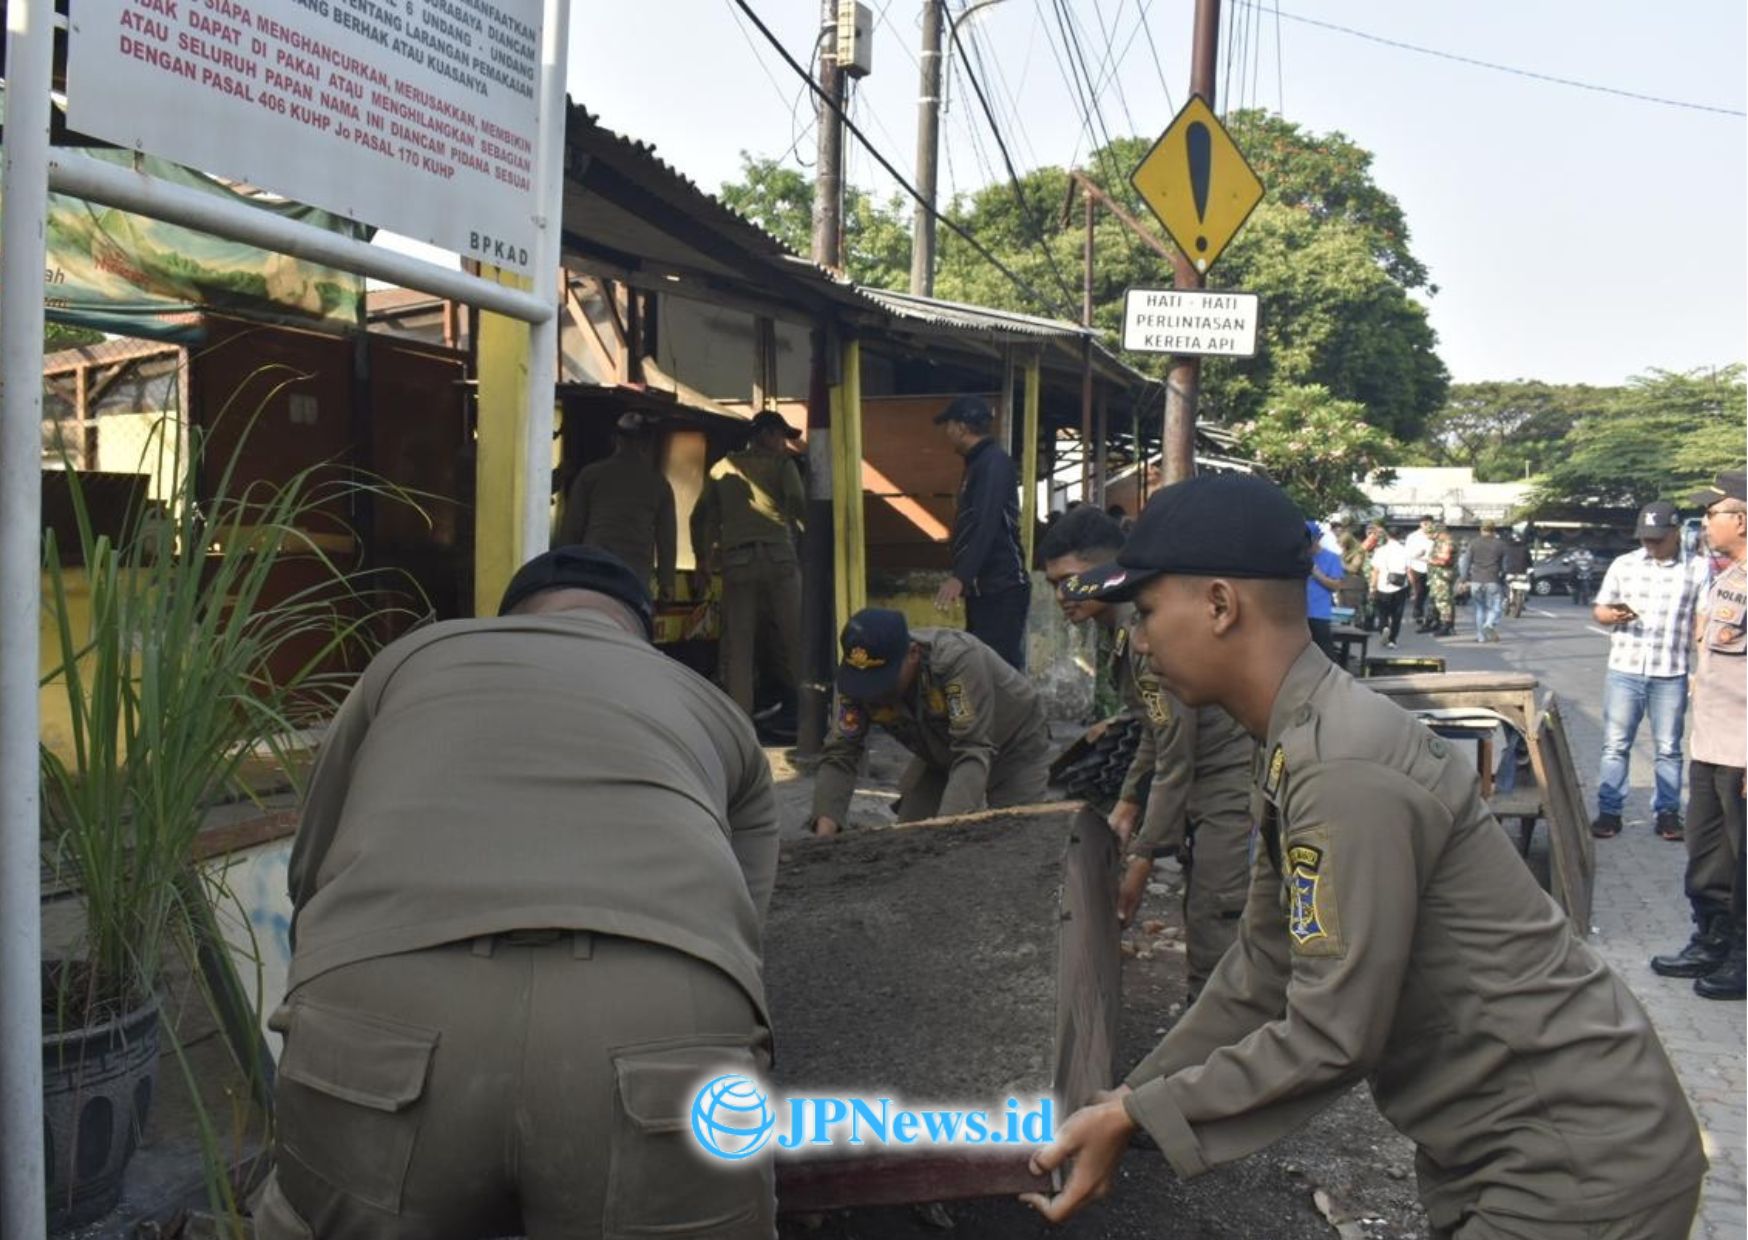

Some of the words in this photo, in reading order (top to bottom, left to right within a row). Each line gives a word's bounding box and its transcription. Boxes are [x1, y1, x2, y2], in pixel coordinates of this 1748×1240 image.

[333, 6, 389, 47] BERHAK
[391, 37, 424, 64] ATAU
[427, 54, 488, 97] KUASANYA
[342, 0, 402, 31] ENTANG
[405, 22, 469, 67] LARANGAN
[472, 57, 533, 99] PEMAKAIAN
[422, 9, 472, 47] UNDANG
[490, 46, 534, 80] UNDANG
[423, 0, 482, 33] URABAYA
[487, 25, 535, 61] DIANCAM
[120, 9, 169, 42] ATAU
[178, 32, 257, 78] SELURUH
[265, 68, 313, 100] PAPAN
[320, 92, 360, 121] NAMA
[366, 111, 384, 130] INI
[390, 123, 446, 156] DIANCAM
[451, 149, 490, 176] PIDANA
[495, 168, 530, 191] SESUAI
[120, 35, 196, 80] DENGAN
[203, 66, 254, 102] PASAL
[258, 91, 286, 114] 406
[290, 102, 331, 131] KUHP
[335, 123, 351, 140] Jo
[354, 129, 395, 158] PASAL
[399, 147, 420, 166] 170
[423, 157, 455, 180] KUHP
[189, 10, 242, 46] DAPAT
[251, 37, 267, 58] DI
[277, 49, 320, 81] PAKAI
[329, 73, 363, 99] ATAU
[371, 91, 475, 146] MENGHILANGKAN
[481, 140, 531, 173] SEBAGIAN
[257, 15, 391, 92] MENGHANCURKAN,
[394, 78, 478, 131] MERUSAKKAN,
[481, 119, 531, 154] MEMBIKIN
[470, 231, 529, 267] BPKAD
[1136, 314, 1245, 331] PERLINTASAN
[1144, 335, 1201, 349] KERETA
[1207, 337, 1235, 350] API
[1146, 295, 1182, 308] HATI
[1202, 296, 1238, 310] HATI
